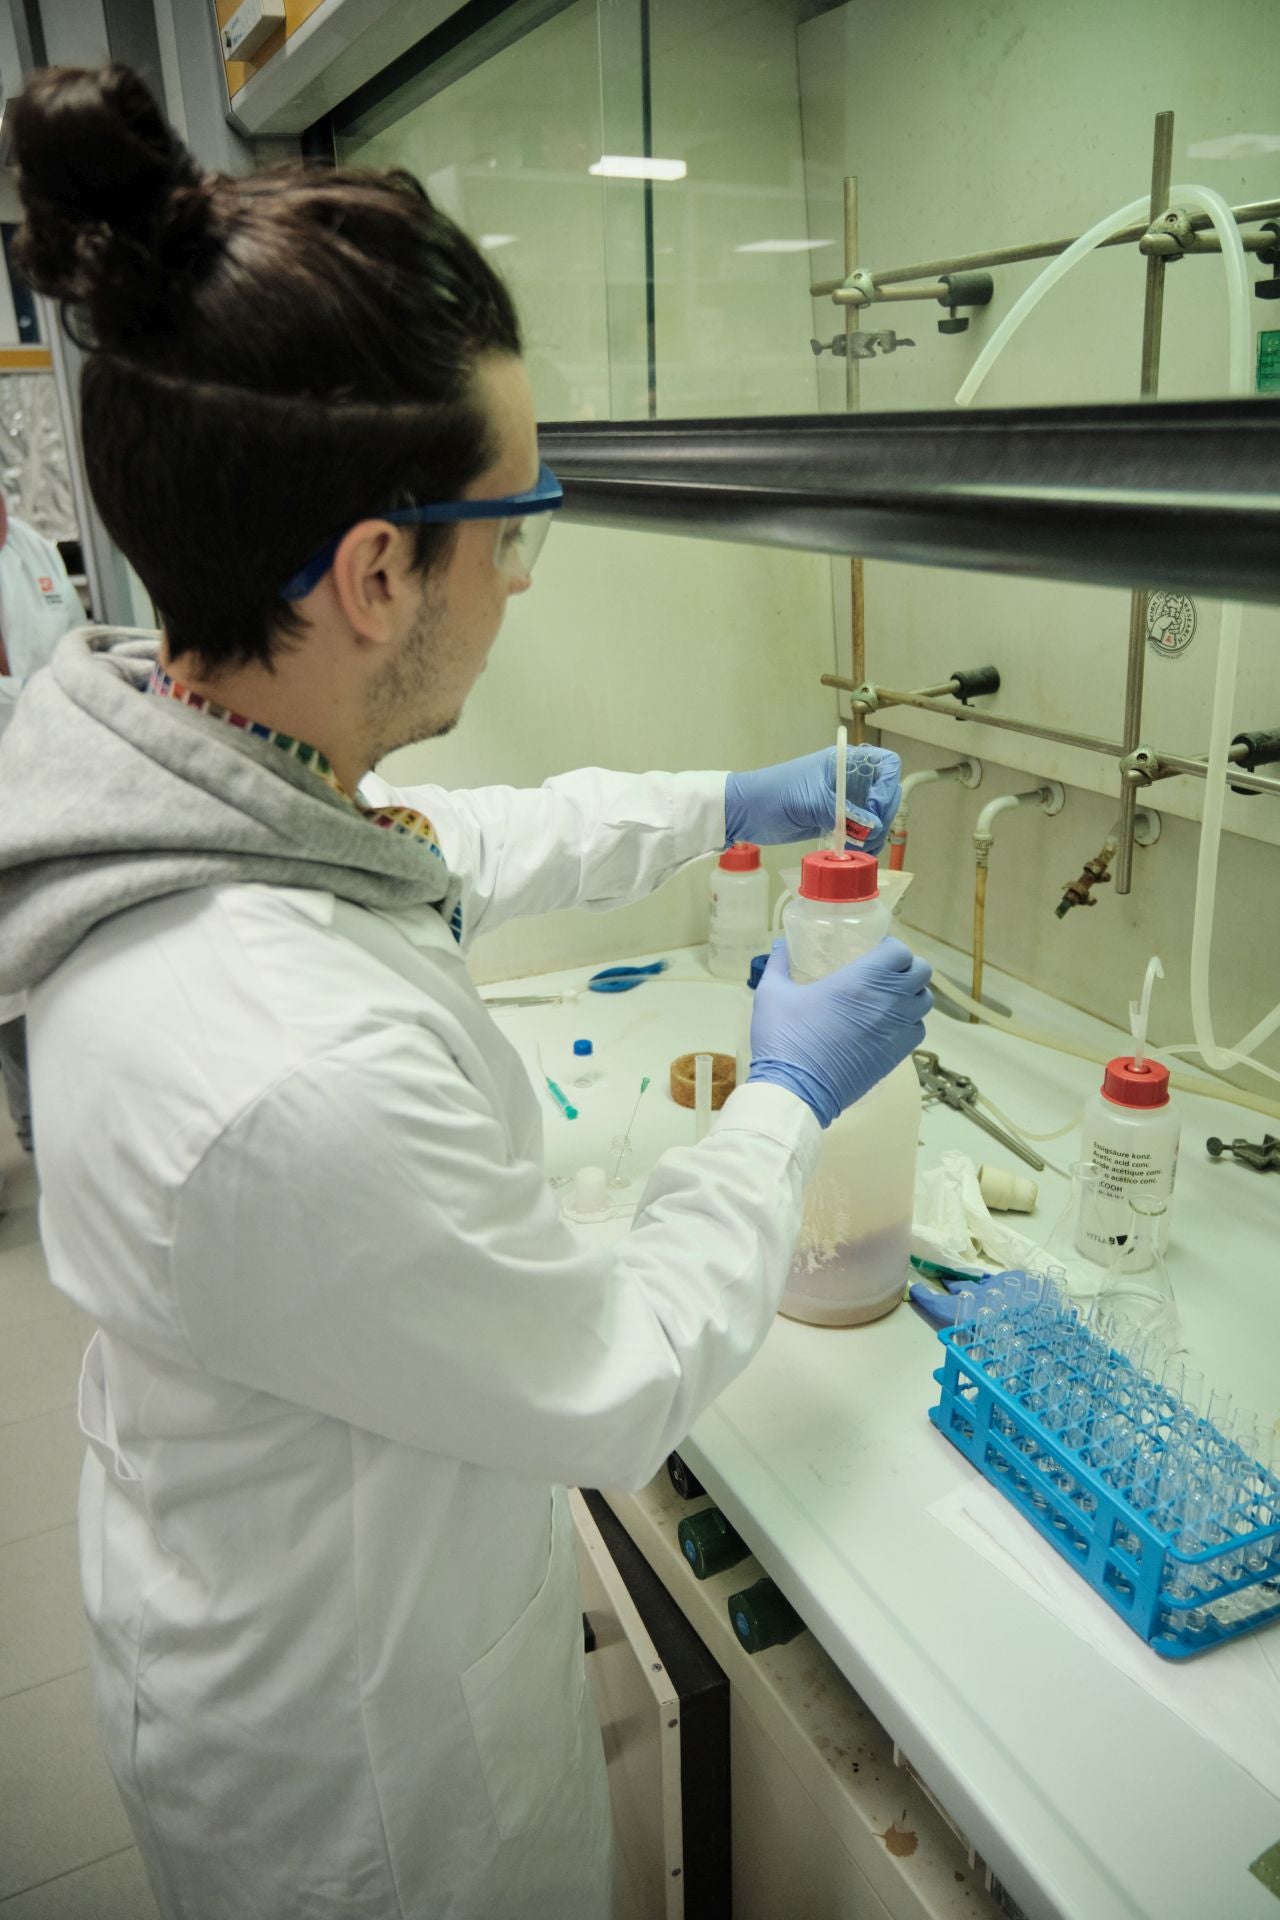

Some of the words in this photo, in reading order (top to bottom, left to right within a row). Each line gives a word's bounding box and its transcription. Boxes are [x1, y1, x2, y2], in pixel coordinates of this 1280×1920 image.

[1149, 600, 1157, 622] BORN
[1177, 602, 1193, 644] RESEARCH
[1093, 1150, 1112, 1163] Acetic
[1111, 1167, 1145, 1177] acétique
[1110, 1175, 1138, 1185] acético
[1099, 1181, 1123, 1192] COOH
[1086, 1232, 1116, 1246] VITLAB
